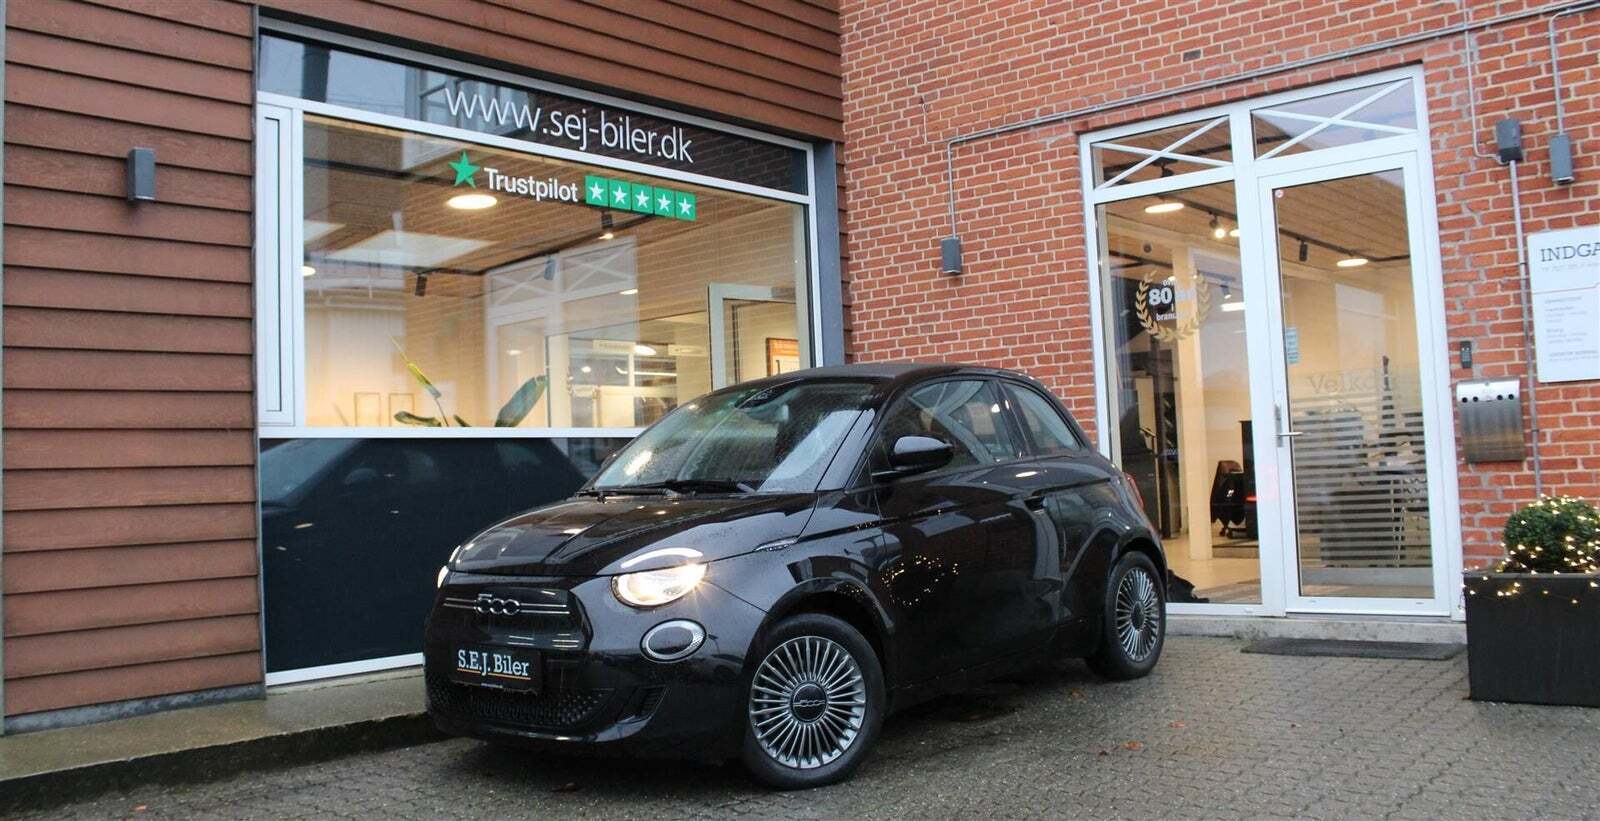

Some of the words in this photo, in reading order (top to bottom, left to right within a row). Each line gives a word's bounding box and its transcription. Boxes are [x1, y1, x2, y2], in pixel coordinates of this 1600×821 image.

[444, 87, 695, 164] www.sej-biler.dk
[484, 167, 579, 203] Trustpilot
[1148, 287, 1173, 306] 80
[477, 592, 521, 616] 500
[457, 649, 491, 676] S.E.J.
[493, 653, 530, 677] Biler
